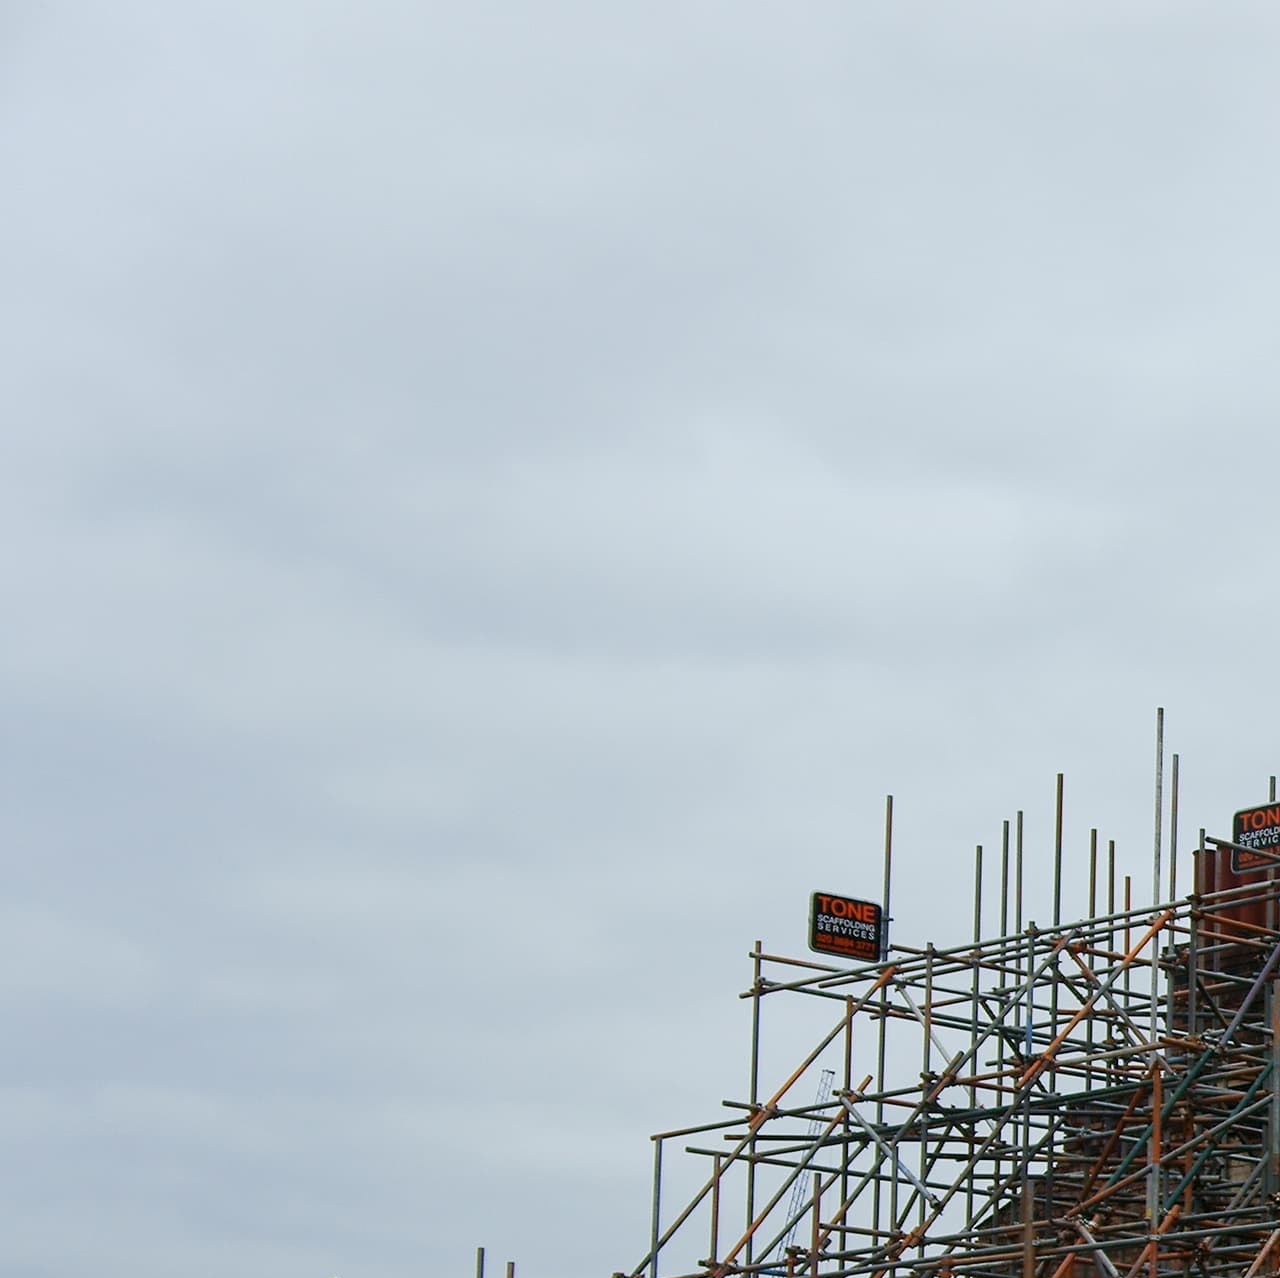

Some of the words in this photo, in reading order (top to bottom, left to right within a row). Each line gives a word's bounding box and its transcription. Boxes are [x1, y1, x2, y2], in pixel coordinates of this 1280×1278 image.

[818, 895, 876, 923] TONE
[817, 914, 875, 932] SCAFFOLDING
[817, 922, 875, 940] SERVICES
